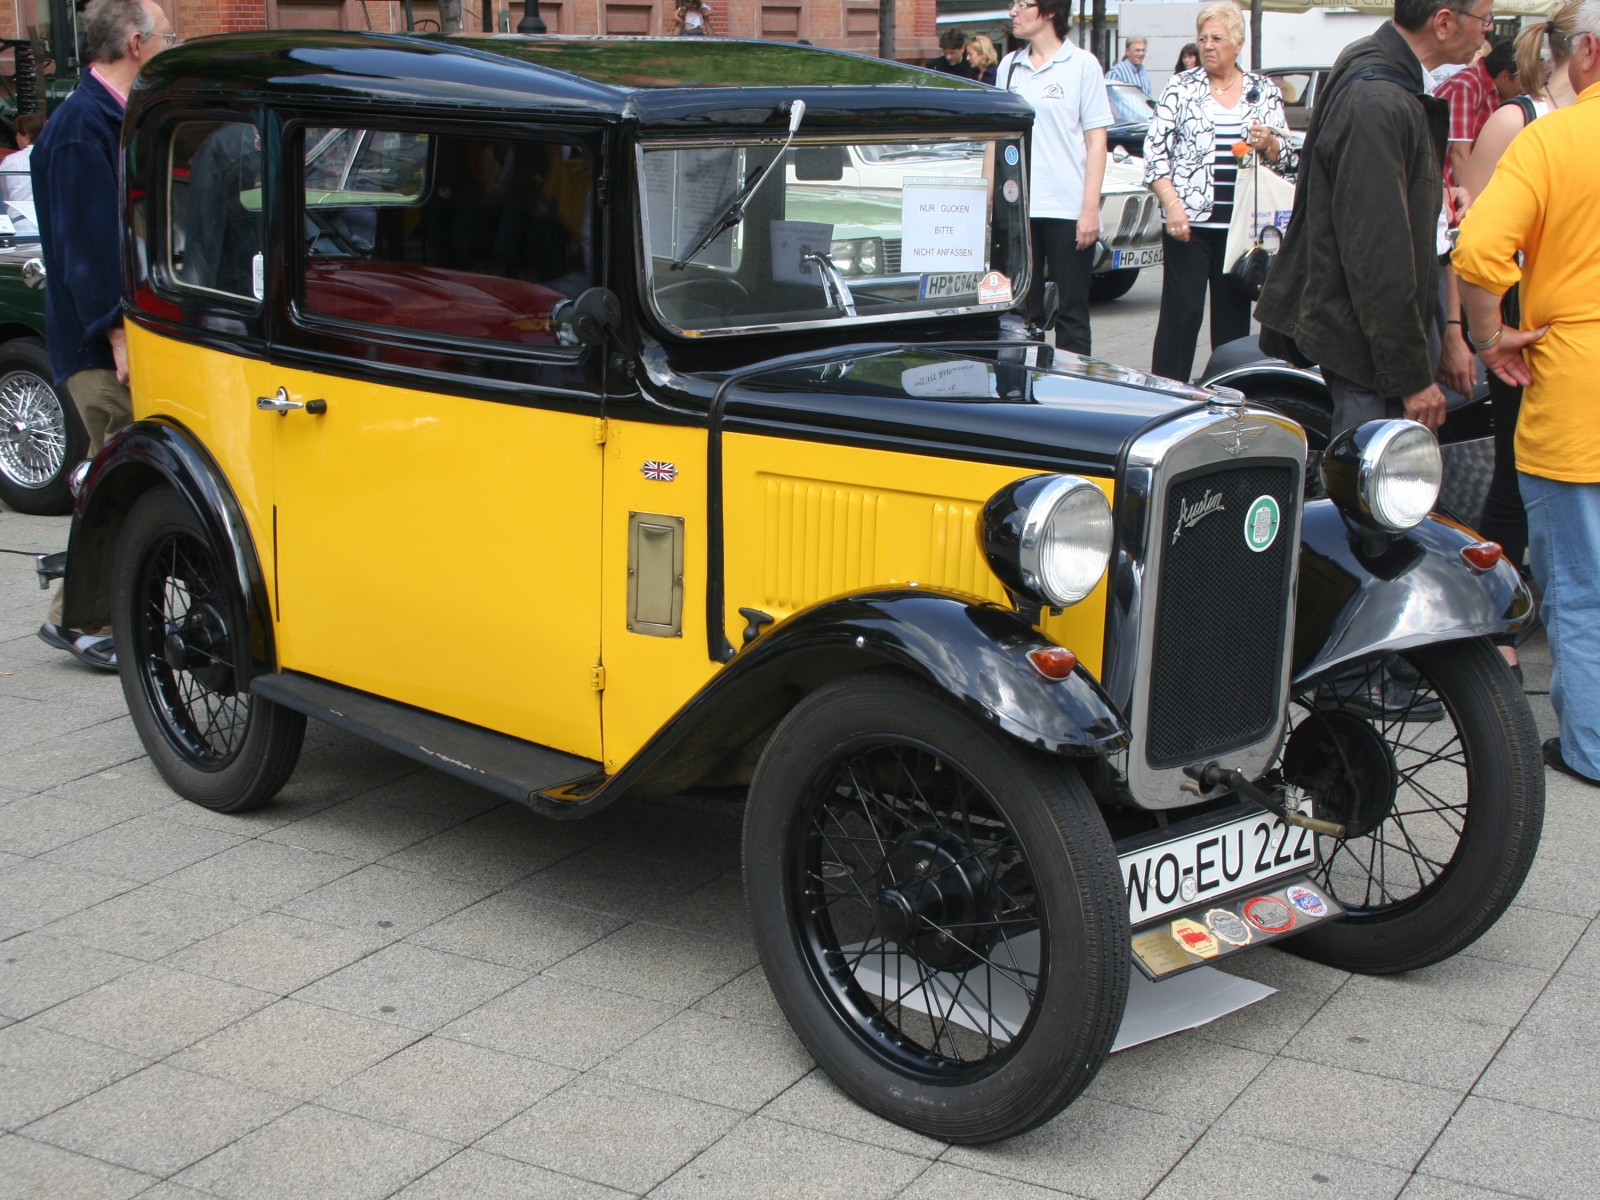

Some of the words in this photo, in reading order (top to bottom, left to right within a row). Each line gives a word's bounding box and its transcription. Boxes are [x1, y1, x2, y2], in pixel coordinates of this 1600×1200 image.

[920, 204, 935, 213] NUR
[940, 205, 970, 213] GUCKEN
[934, 227, 954, 235] BITTE
[914, 248, 934, 257] NICHT
[936, 249, 973, 257] ANFASSEN
[1120, 251, 1135, 266] HP
[929, 276, 947, 295] HP
[1172, 489, 1225, 545] Austin
[1253, 810, 1311, 873] 222
